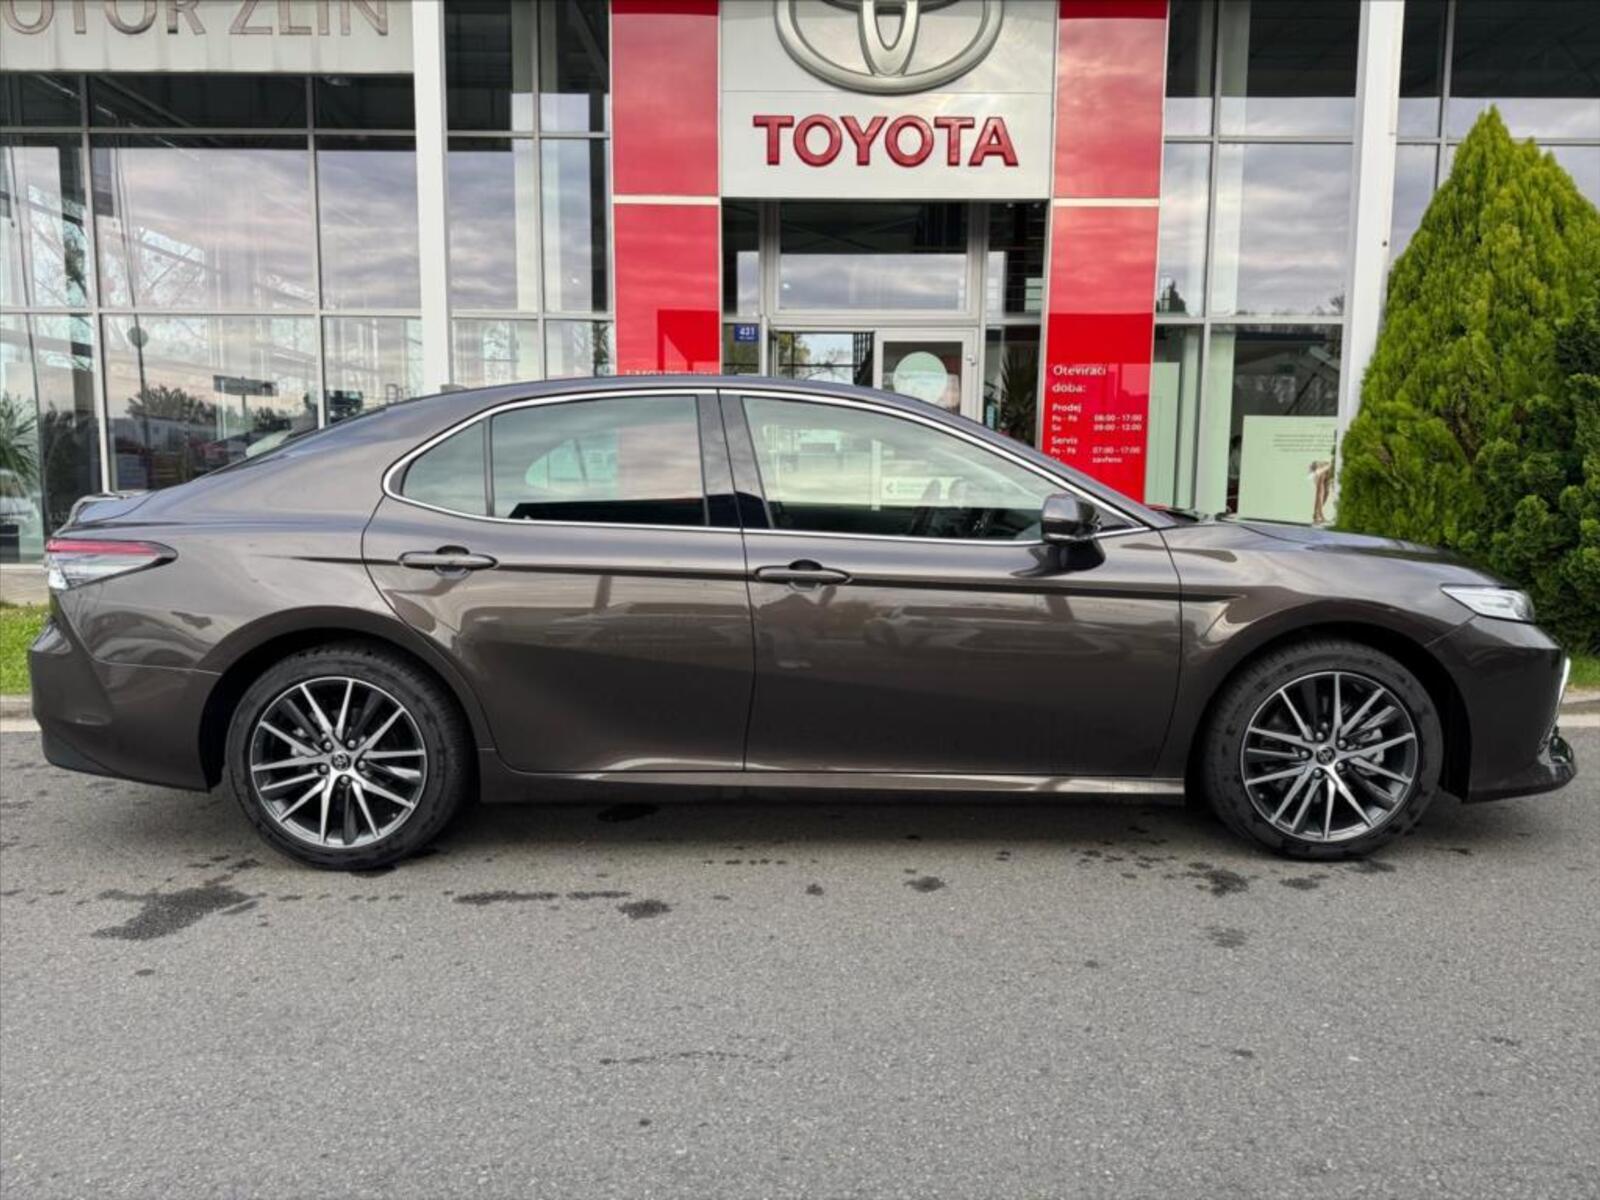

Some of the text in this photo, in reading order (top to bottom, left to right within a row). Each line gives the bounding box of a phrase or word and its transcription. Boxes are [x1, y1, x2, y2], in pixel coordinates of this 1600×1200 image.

[753, 114, 1019, 167] TOYOTA
[1052, 382, 1087, 393] doba:
[1052, 403, 1082, 414] Prodej
[1051, 436, 1078, 445] Servis
